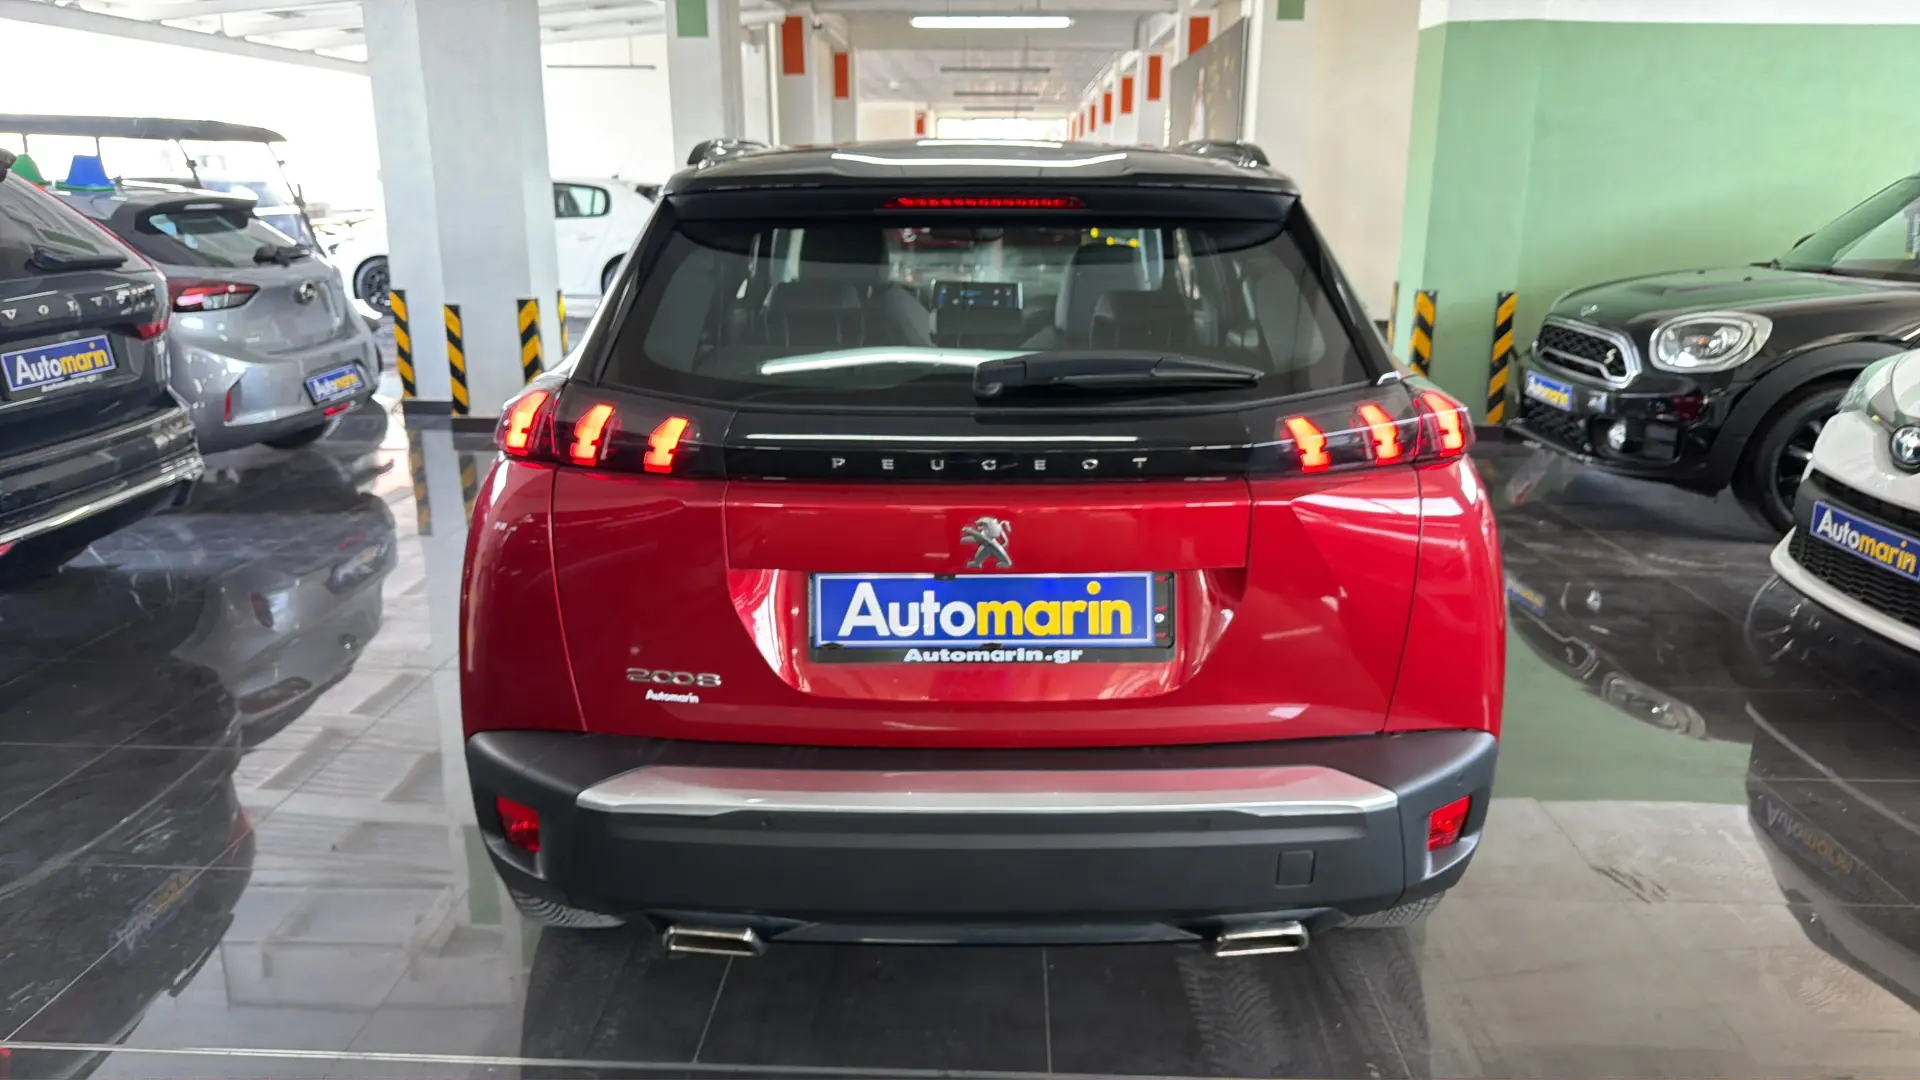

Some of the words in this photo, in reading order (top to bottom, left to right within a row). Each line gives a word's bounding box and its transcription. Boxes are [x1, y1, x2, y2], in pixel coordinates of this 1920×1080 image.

[15, 342, 109, 385] Automarin
[831, 456, 1148, 471] PEUGEOT
[1817, 508, 1917, 574] Automarin
[837, 581, 1132, 637] Automarin
[903, 648, 1083, 664] Automarin.gr
[626, 667, 723, 687] 2008
